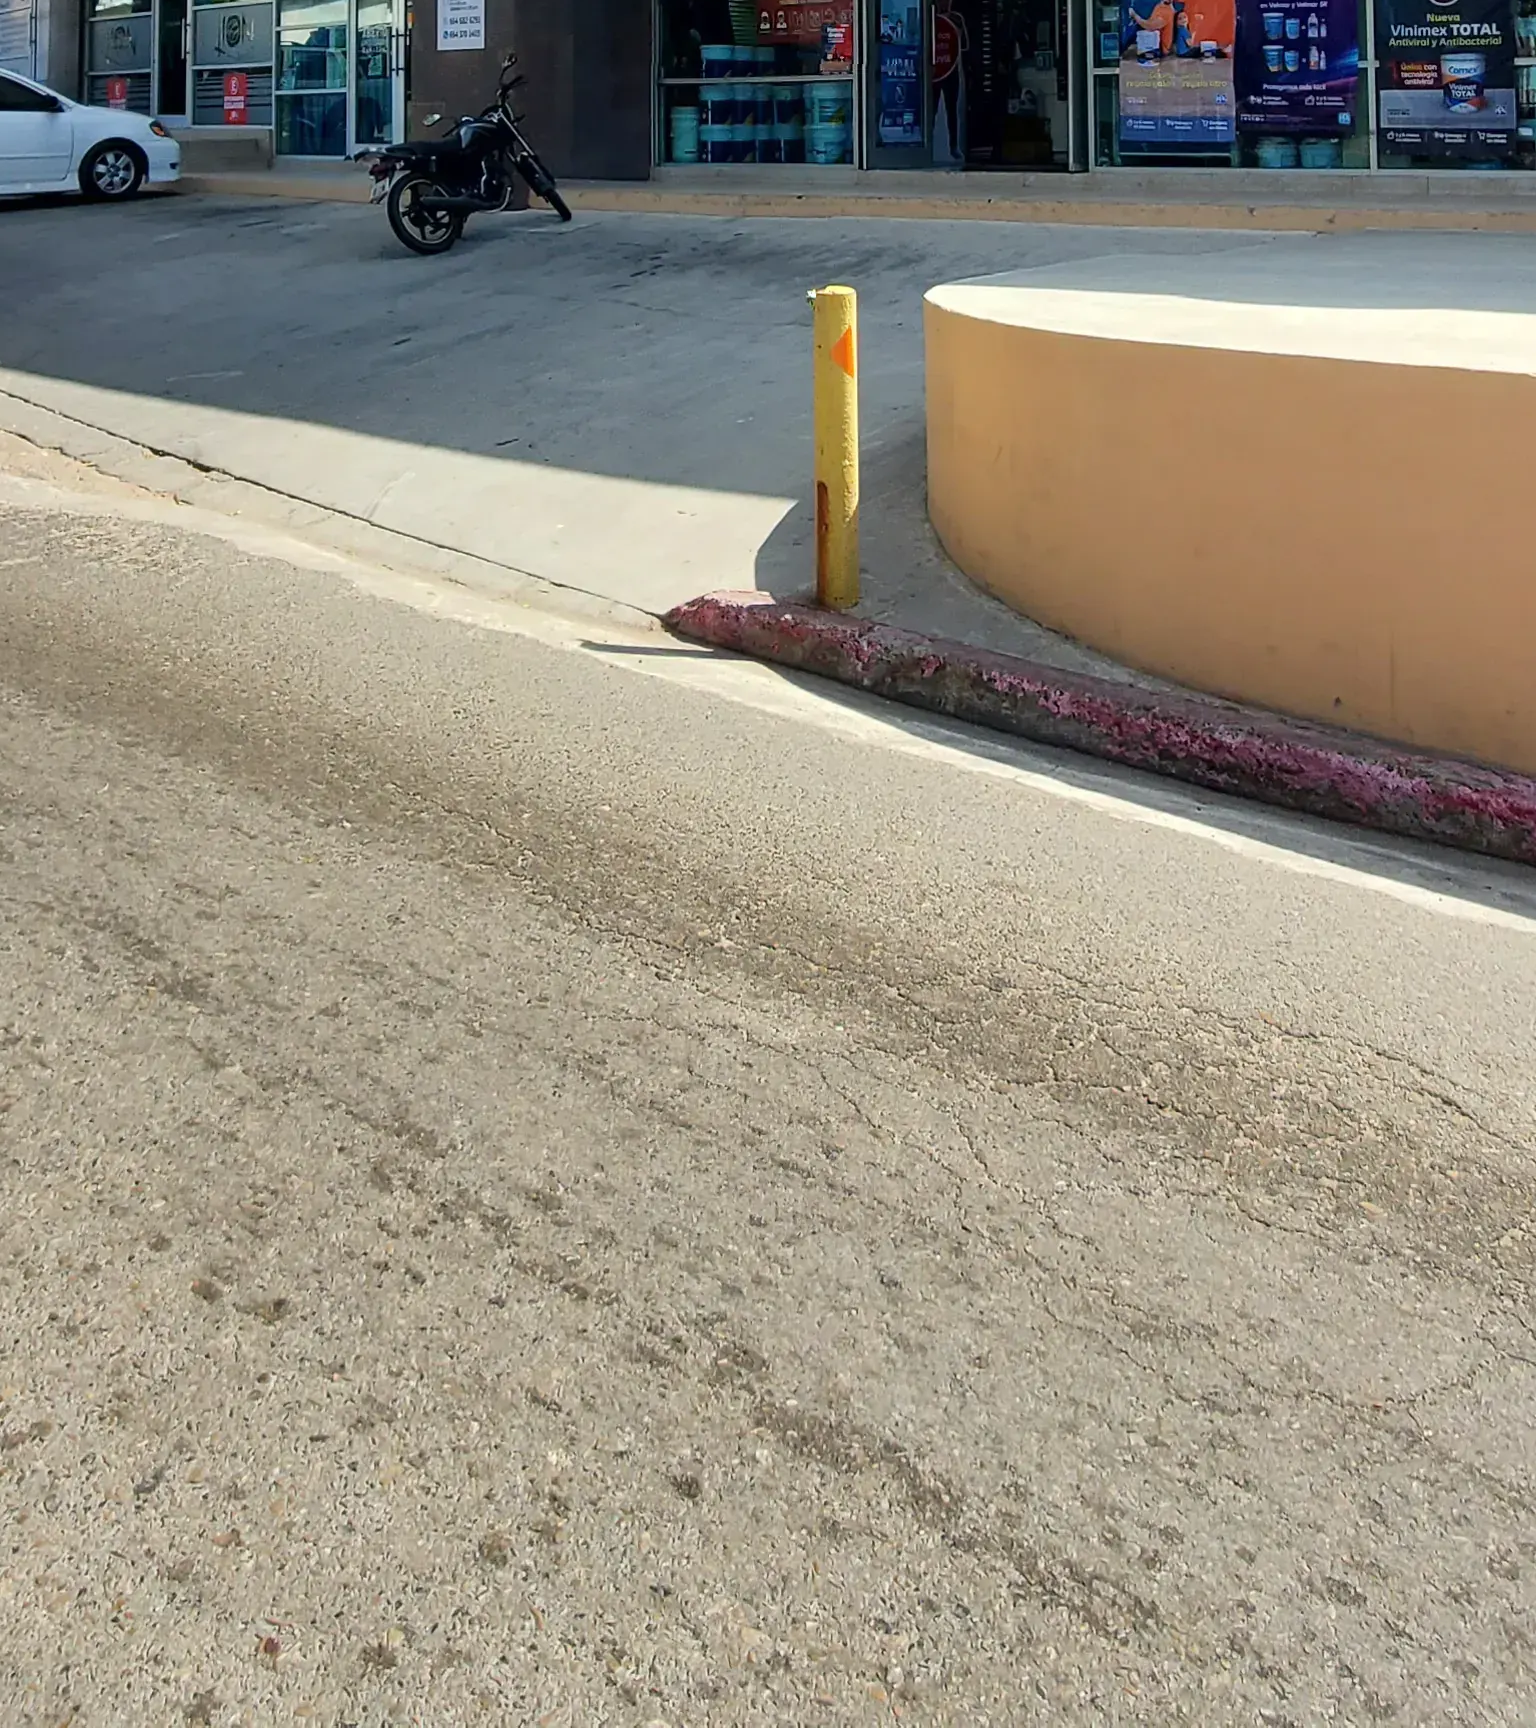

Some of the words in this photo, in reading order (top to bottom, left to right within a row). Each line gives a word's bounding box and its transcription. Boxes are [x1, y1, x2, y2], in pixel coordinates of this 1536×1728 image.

[1426, 13, 1460, 22] Nueva
[1390, 24, 1448, 37] Vinimex
[1450, 23, 1501, 36] TOTAL
[1389, 37, 1430, 47] Antiviral
[1431, 39, 1438, 48] y
[1439, 37, 1502, 47] Antibacterial
